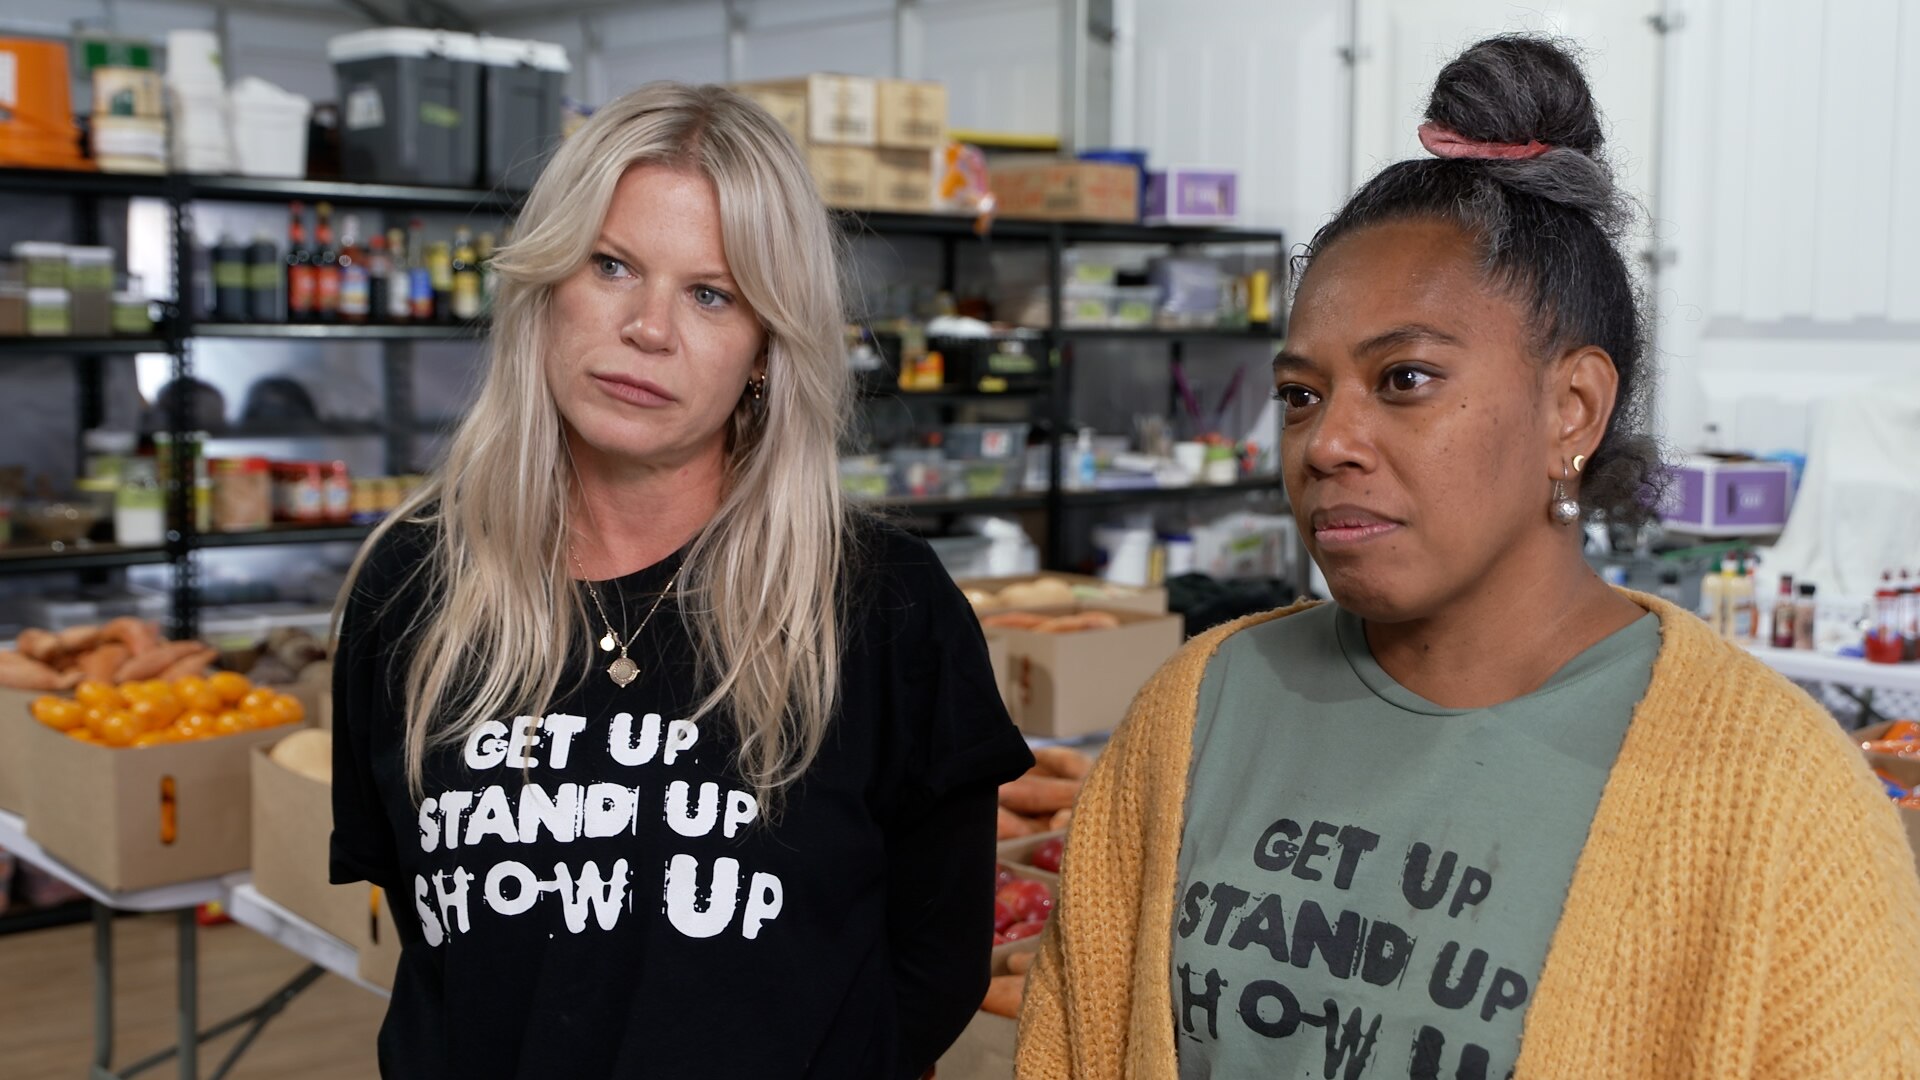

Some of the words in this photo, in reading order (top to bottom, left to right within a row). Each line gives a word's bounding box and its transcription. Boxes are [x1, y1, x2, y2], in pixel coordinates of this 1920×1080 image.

[463, 712, 587, 769] GET
[607, 712, 699, 766] UP
[418, 781, 640, 853] STAND
[663, 780, 760, 838] UP
[415, 858, 632, 947] SHOW
[663, 853, 783, 940] UP
[1253, 818, 1381, 890] GET
[1401, 842, 1492, 917] UP
[1178, 881, 1417, 991] STAND
[1428, 940, 1528, 1022] UP
[1176, 962, 1383, 1080] HOW
